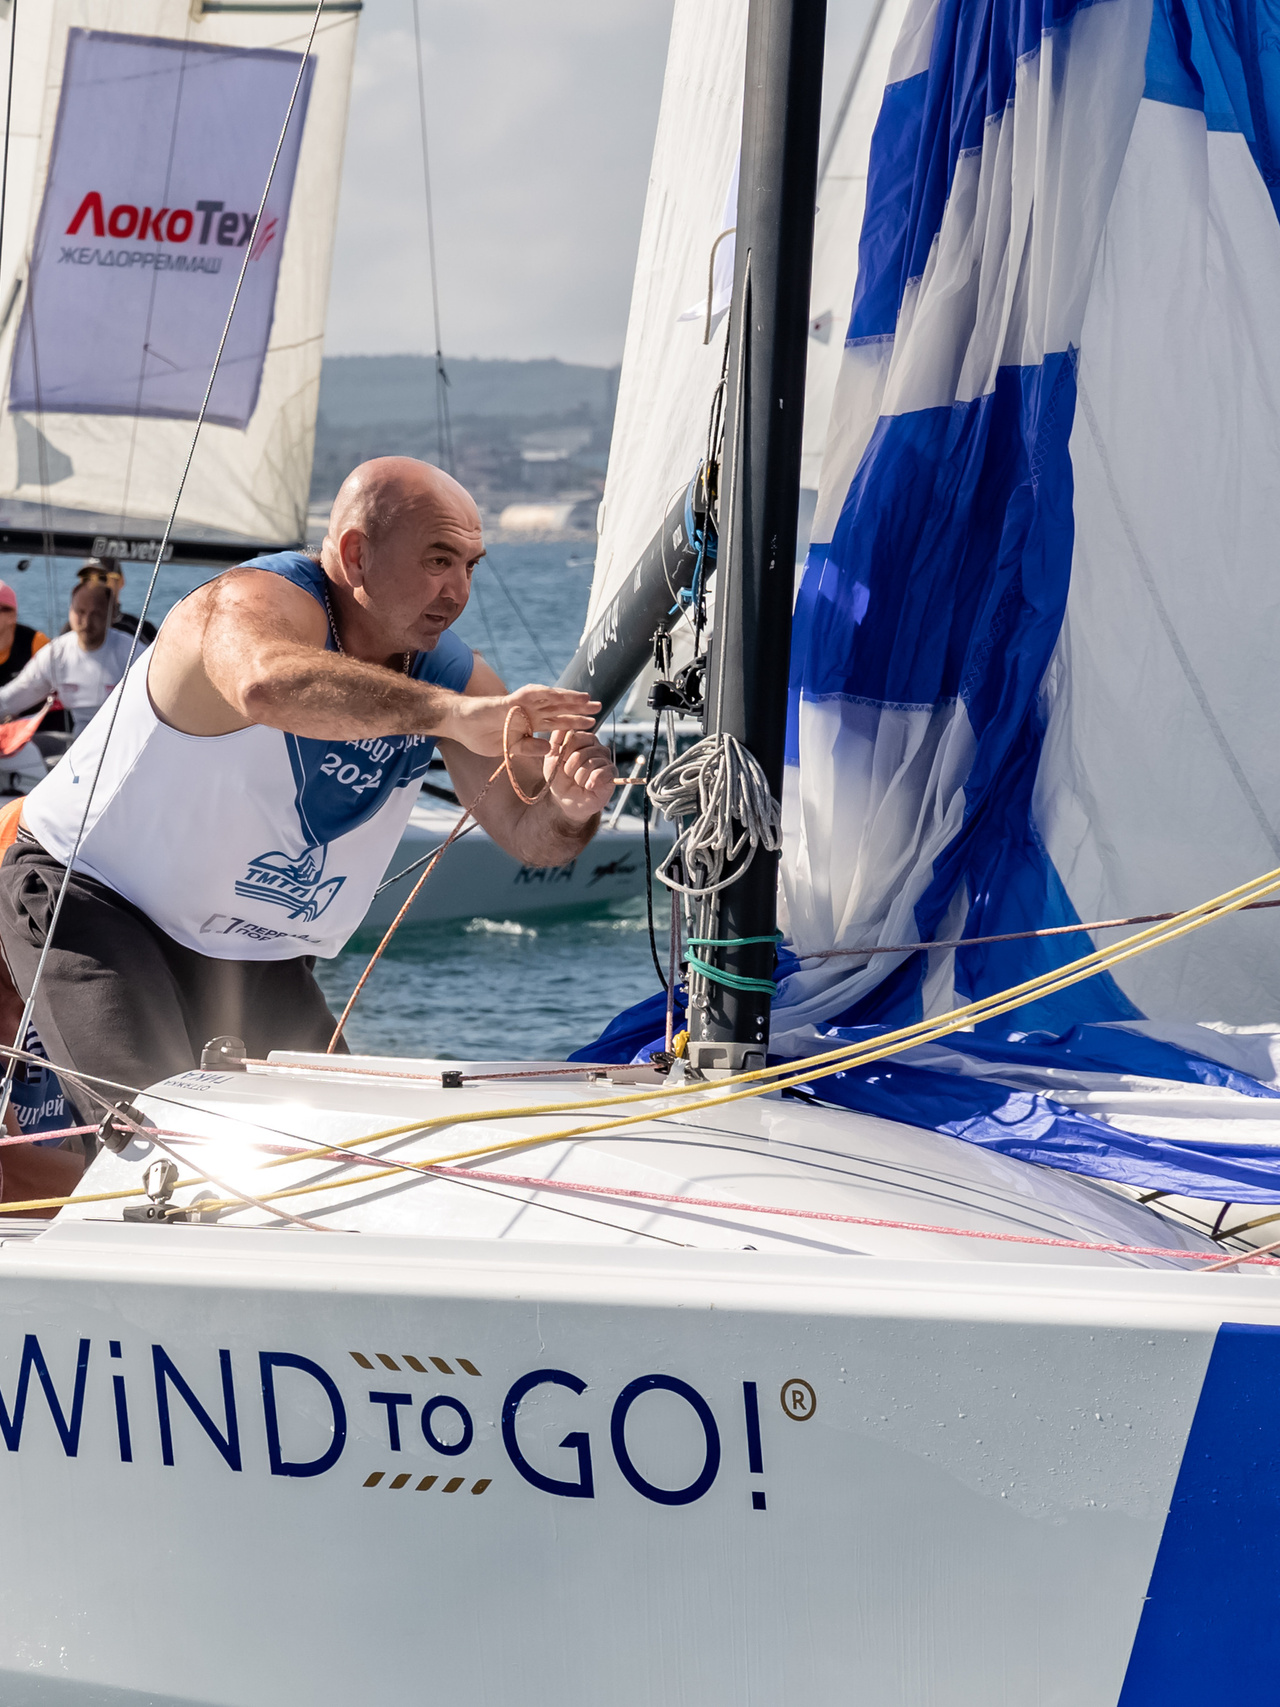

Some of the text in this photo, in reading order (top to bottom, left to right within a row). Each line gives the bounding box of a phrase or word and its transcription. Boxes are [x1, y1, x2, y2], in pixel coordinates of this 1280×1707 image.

[65, 191, 261, 248] ЛокоТех
[57, 246, 222, 275] ЖЕЛДОРРЕММАШ
[244, 868, 311, 898] ТМТП
[369, 1391, 475, 1456] TO
